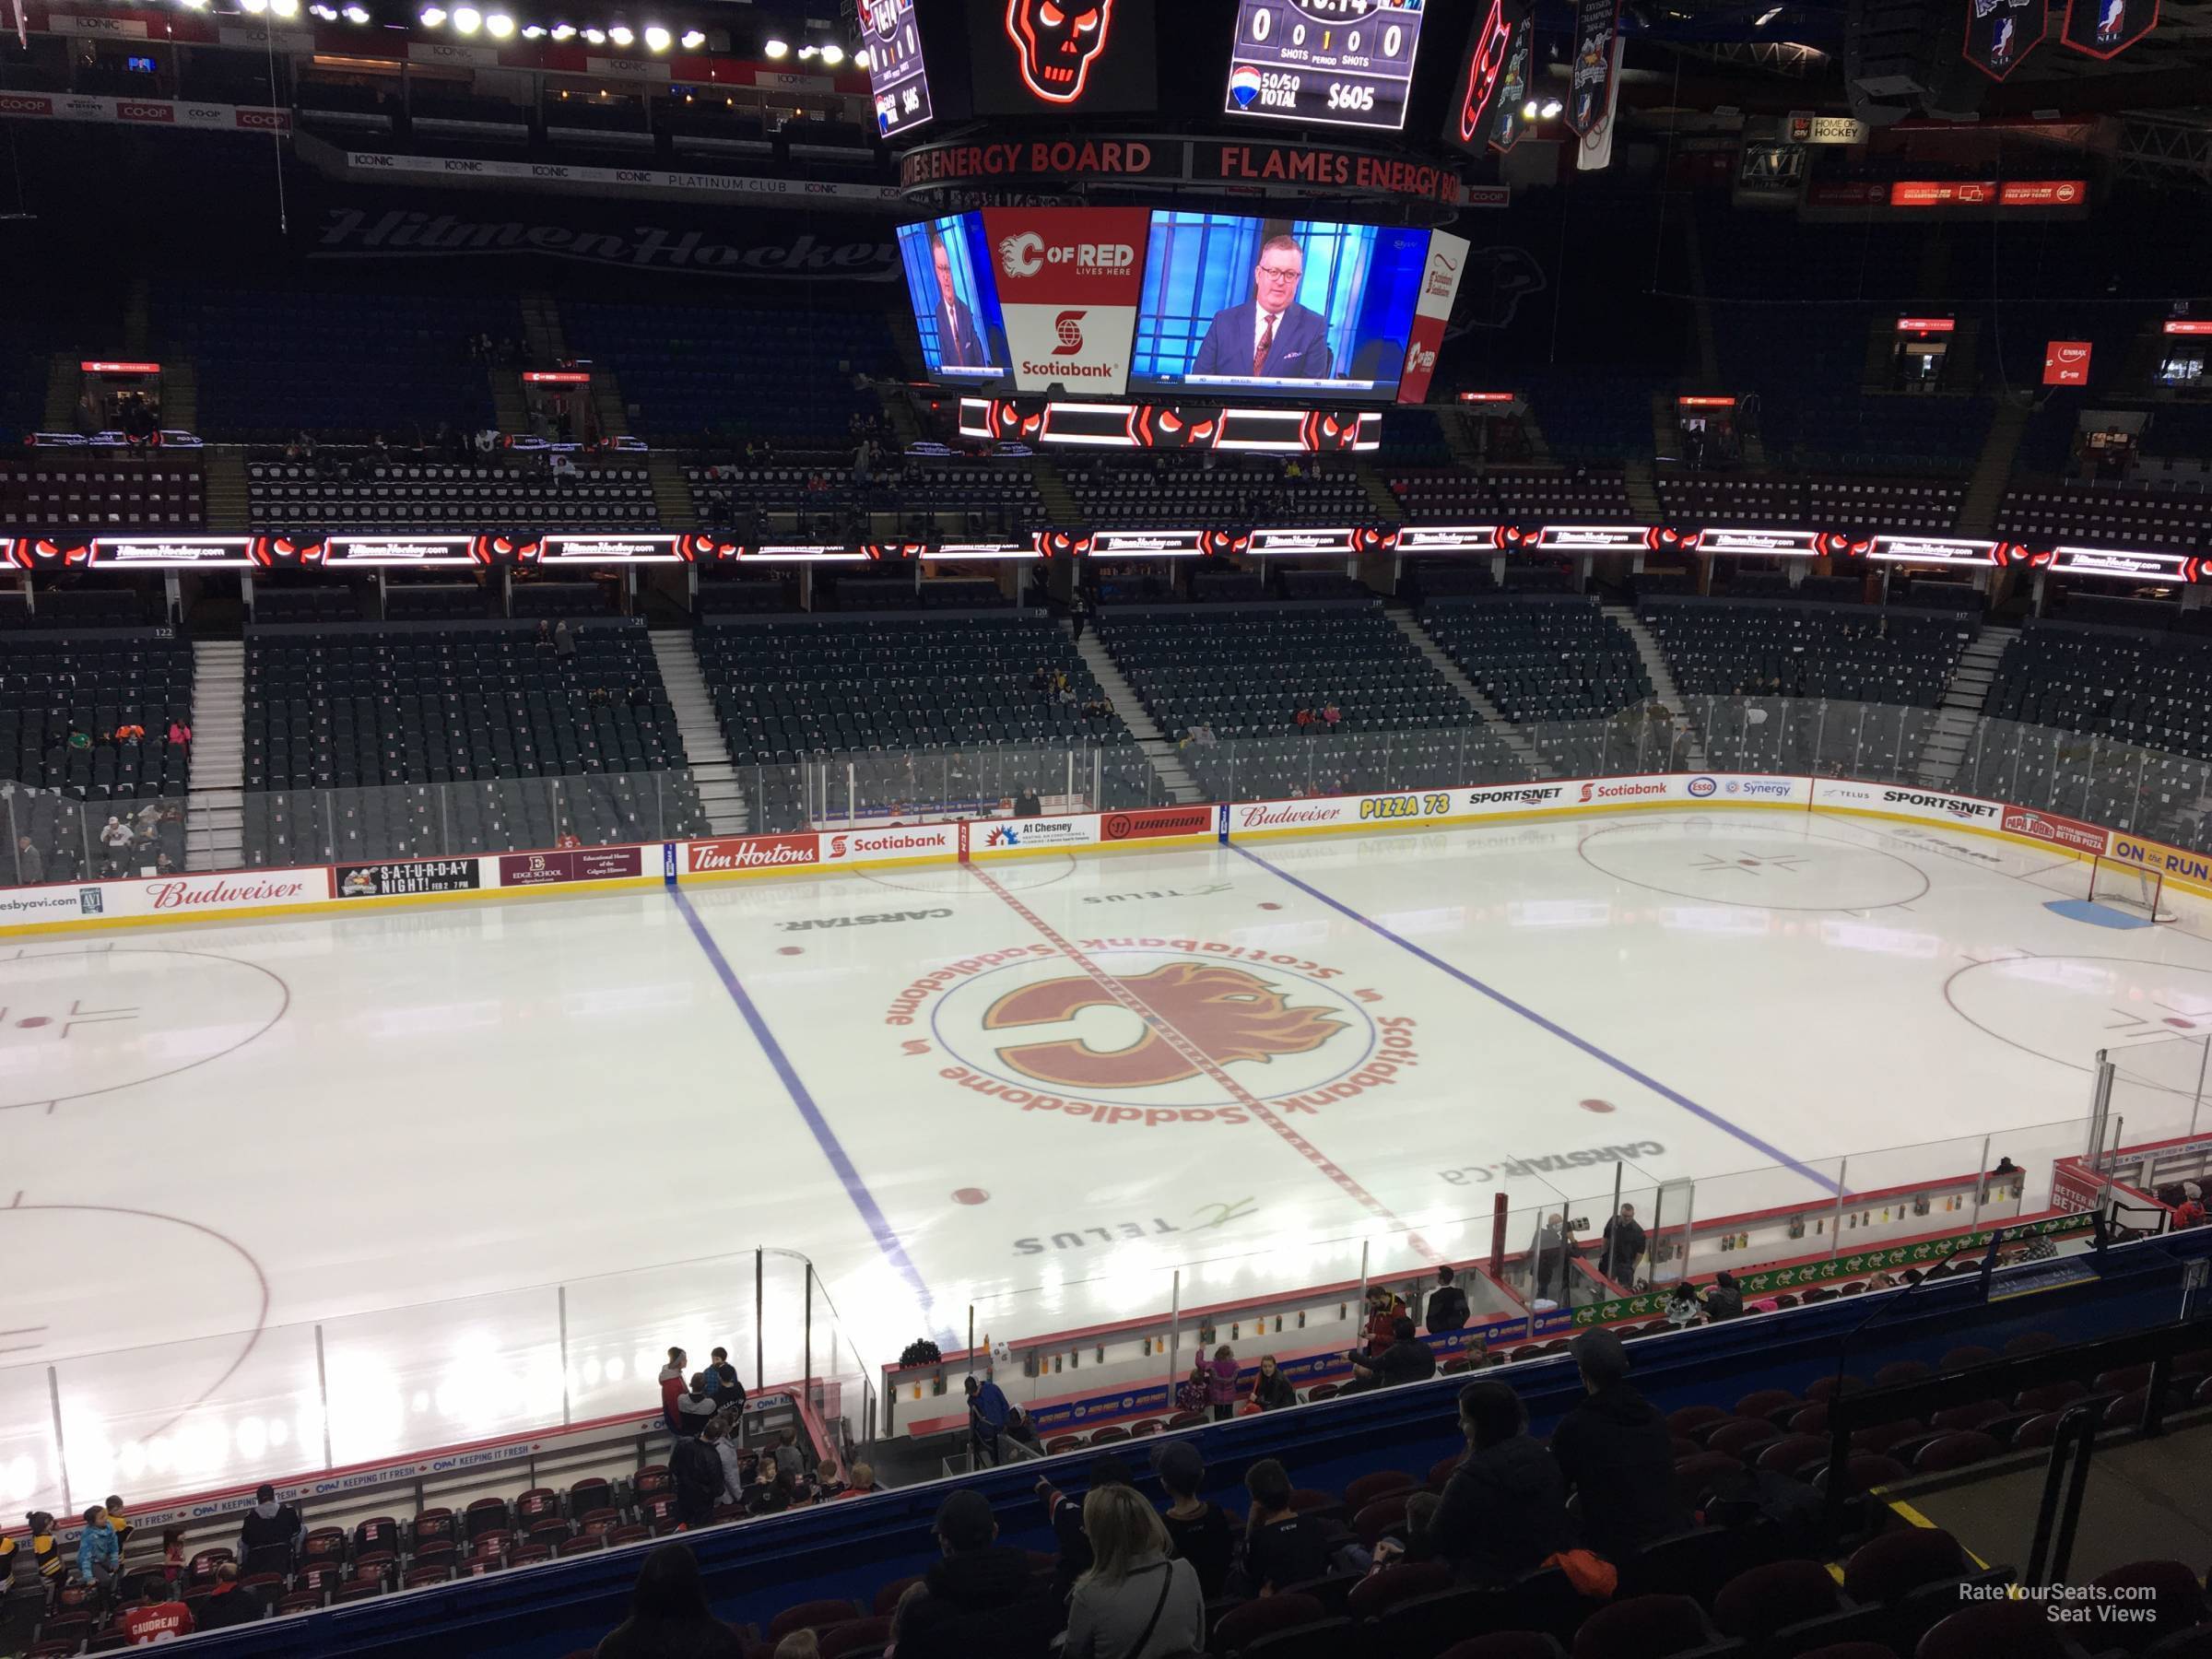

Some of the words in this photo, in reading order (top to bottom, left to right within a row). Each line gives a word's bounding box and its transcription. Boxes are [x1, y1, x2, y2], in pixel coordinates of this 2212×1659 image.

[76, 18, 120, 30] ICONIC
[1253, 8, 1271, 41] 0
[1293, 24, 1305, 45] 0
[1324, 30, 1331, 50] 1
[1347, 31, 1360, 52] 0
[1383, 25, 1401, 57] 0
[1281, 48, 1309, 61] SHOTS
[1312, 55, 1336, 65] PERIOD
[1342, 55, 1370, 67] SHOTS
[1262, 73, 1300, 91] 50/50
[1, 100, 45, 110] CO-OP
[1261, 90, 1297, 108] TOTAL
[1327, 82, 1375, 111] $605
[123, 107, 168, 118] CO-OP
[189, 109, 221, 117] CO-OP
[243, 114, 285, 125] CO-OP
[1815, 128, 1858, 137] HOCKEY
[1816, 120, 1843, 128] HOME
[1844, 120, 1855, 128] OF
[355, 155, 393, 167] ICONIC
[445, 159, 482, 171] ICONIC
[931, 143, 1024, 180] ENERGY
[1031, 142, 1151, 173] BOARD
[532, 165, 569, 177] ICONIC
[617, 171, 651, 182] ICONIC
[1220, 147, 1349, 184] FLAMES
[1356, 156, 1440, 197] ENERGY
[669, 175, 744, 190] PLATINUM
[749, 180, 786, 193] CLUB
[805, 183, 837, 194] ICONIC
[1473, 192, 1504, 201] CO-OP
[319, 208, 631, 259] Hitmen
[624, 227, 901, 282] Hockey
[1047, 246, 1075, 264] OF
[1077, 244, 1135, 267] RED
[1077, 267, 1103, 276] LIVES
[1107, 267, 1131, 276] HERE
[2063, 348, 2087, 358] ENMAX
[1022, 361, 1112, 378] Scotiabank
[1956, 611, 1968, 619] 117
[156, 628, 173, 636] 122
[1469, 787, 1563, 804] SPORTSNET
[1597, 782, 1666, 797] Scotiabank
[1691, 782, 1712, 792] Esso
[1743, 782, 1791, 796] Synergy
[1359, 796, 1418, 819] PIZZA
[1424, 794, 1450, 816] 73
[1884, 791, 1999, 818] SPORTSNET
[1134, 815, 1206, 830] WARRIOR
[1241, 806, 1341, 827] Budweiser
[2006, 818, 2028, 830] PAPA
[1023, 824, 1033, 833] A1
[1035, 822, 1072, 832] Chesney
[854, 833, 946, 852] Scotiabank
[2056, 831, 2081, 844] BETTER
[529, 855, 546, 871] E
[693, 844, 731, 870] Tim
[735, 841, 814, 865] Hortons
[2117, 841, 2145, 862] ON
[2147, 853, 2162, 864] the
[2166, 855, 2208, 880] RUN
[381, 862, 468, 879] S-A-T-U-R-D-A-Y
[534, 869, 562, 877] SCHOOL
[382, 877, 429, 894] NIGHT!
[147, 881, 302, 909] Budweiser
[1083, 889, 1179, 905] TELUS
[1079, 938, 1344, 980] Scotiabank
[887, 943, 1053, 1026] Saddledome
[1275, 1016, 1419, 1116] Scotiabank
[939, 1065, 1250, 1126] Saddledome
[2054, 1184, 2087, 1203] BETTER
[1015, 1218, 1180, 1256] TELUS
[433, 1458, 456, 1472] OPA!
[460, 1453, 492, 1465] KEEPING
[493, 1451, 503, 1461] IT
[504, 1445, 528, 1458] FRESH
[315, 1479, 339, 1494] OPA!
[343, 1474, 378, 1488] KEEPING
[379, 1472, 387, 1482] IT
[390, 1468, 415, 1480] FRESH
[193, 1503, 218, 1517] OPA!
[221, 1497, 258, 1512] KEEPING
[276, 1489, 297, 1500] RESH
[146, 1512, 173, 1526] FRESH
[132, 1617, 180, 1635] GAUDREAU
